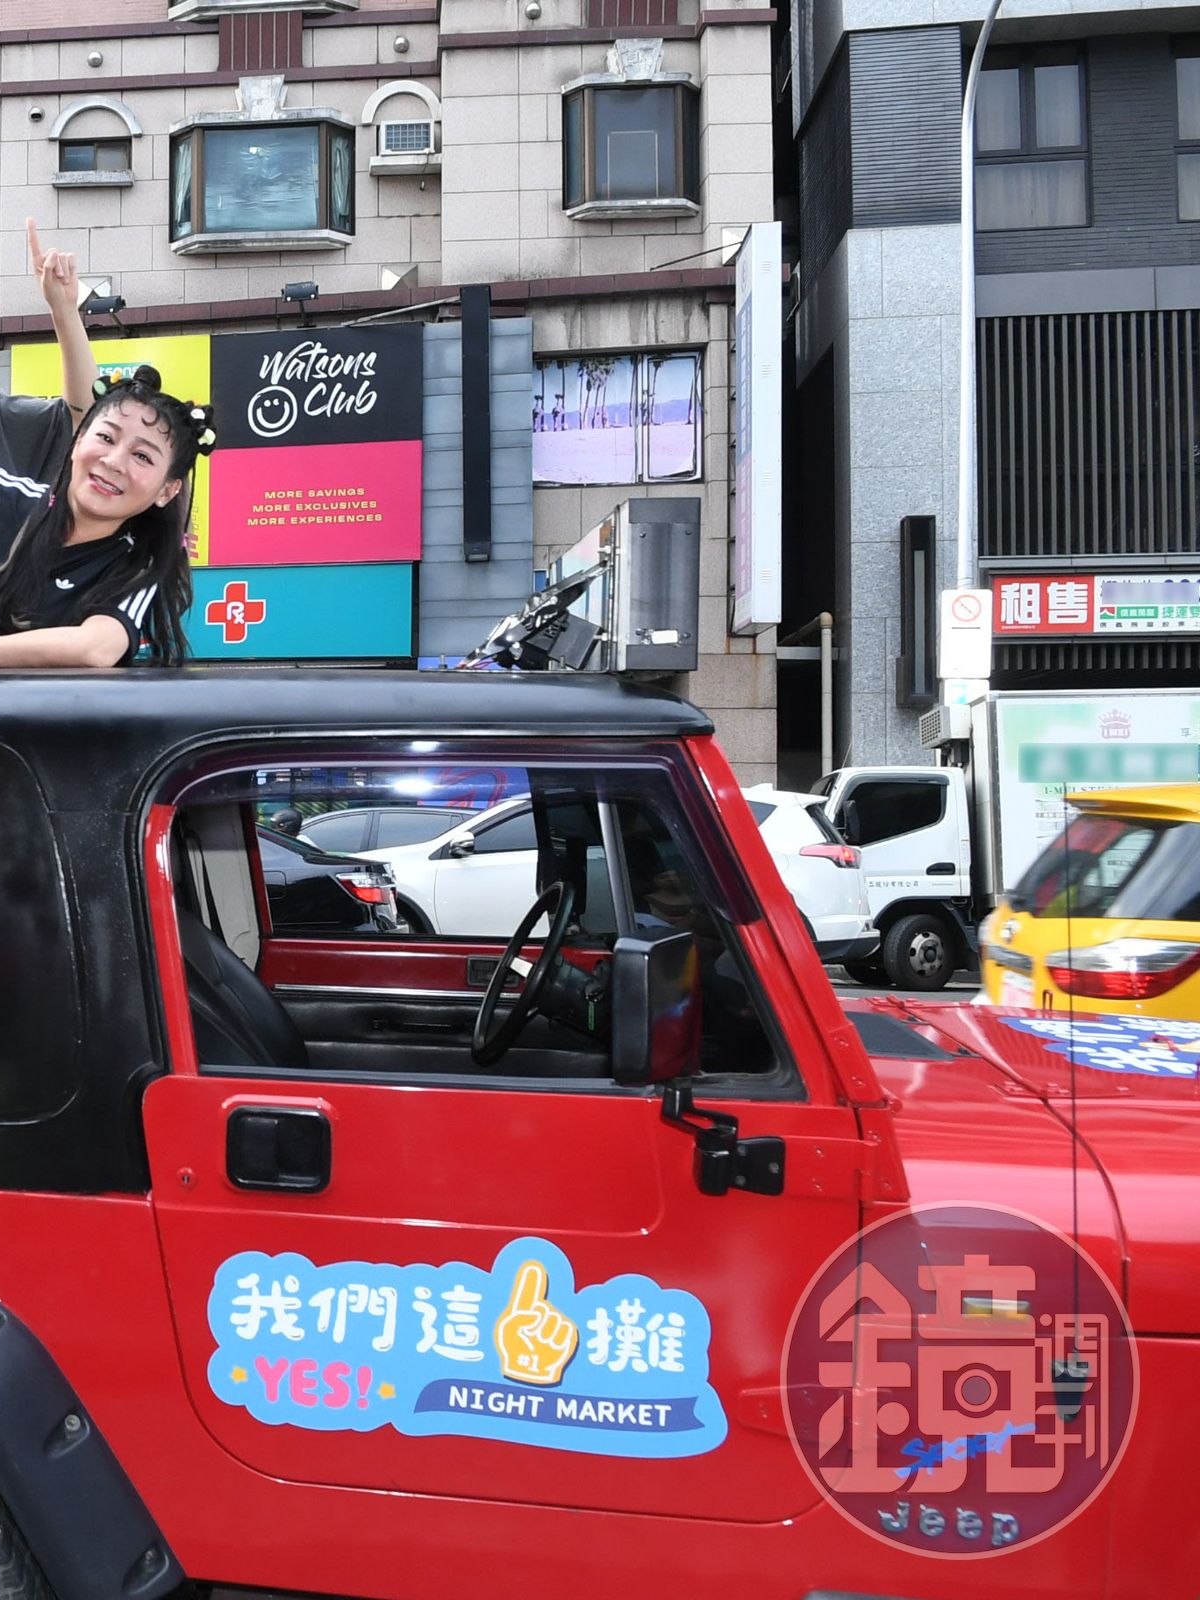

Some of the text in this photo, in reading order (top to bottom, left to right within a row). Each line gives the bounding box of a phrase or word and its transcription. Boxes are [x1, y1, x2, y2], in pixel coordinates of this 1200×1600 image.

[259, 341, 377, 385] Watsons
[304, 380, 377, 417] Club
[252, 501, 377, 512] MORE EXCLUSIVES
[264, 488, 365, 499] MORE SAVINGS
[247, 514, 383, 526] MORE EXPERIENCES
[1001, 582, 1088, 624] 租售
[230, 1273, 685, 1373] 我們這 攤
[254, 1355, 373, 1410] YES!
[517, 1353, 541, 1373] #1
[449, 1384, 672, 1428] NIGHT MARKET
[878, 1501, 1020, 1547] Jeep
